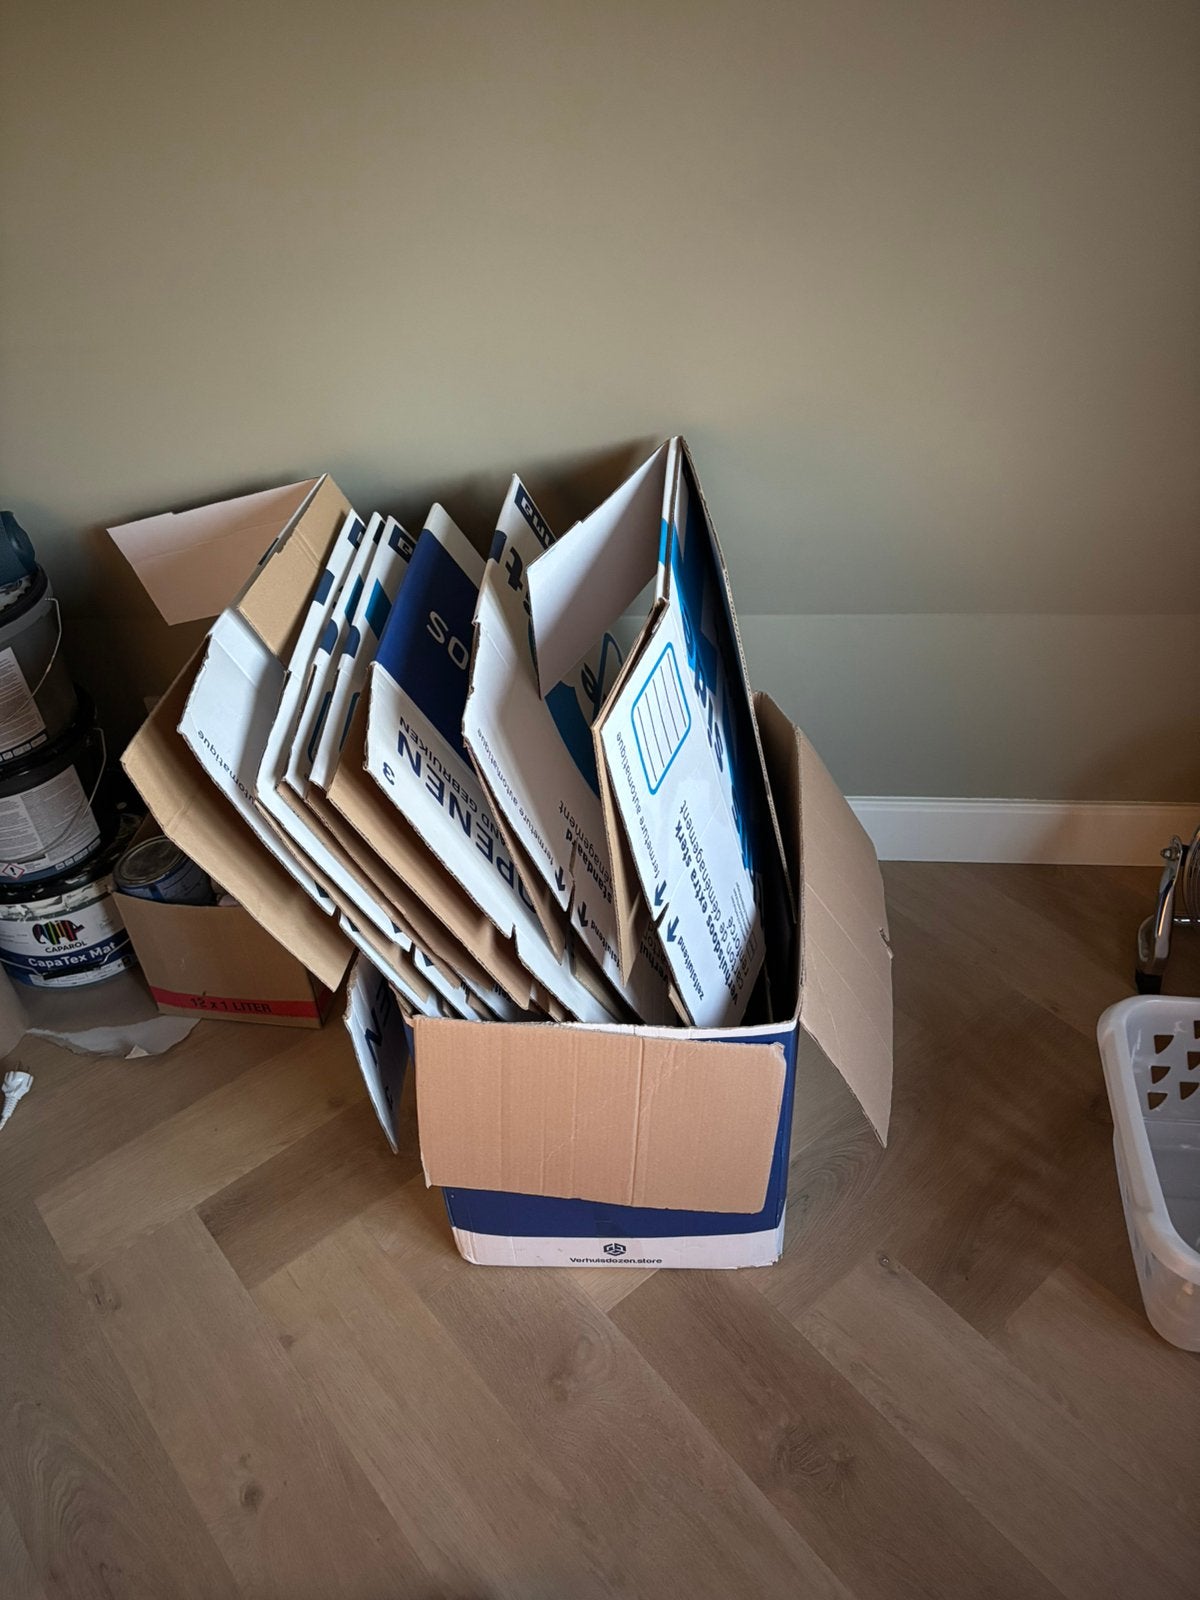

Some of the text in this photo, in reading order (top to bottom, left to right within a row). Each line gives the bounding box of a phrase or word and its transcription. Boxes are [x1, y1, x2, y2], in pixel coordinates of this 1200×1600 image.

[382, 761, 396, 786] 3
[399, 717, 477, 805] GEBRUIKEN
[477, 728, 554, 865] fermeture automatique
[616, 731, 660, 879] fermeture automatique
[679, 800, 721, 922] déménagement
[675, 819, 738, 1005] verhuisdoos extra sterk
[719, 922, 728, 942] de
[28, 942, 116, 968] CapaTex Mat
[45, 941, 88, 954] CAPAROL
[677, 935, 704, 1001] zelfsluitend
[726, 942, 744, 990] carton
[727, 916, 749, 976] renforcé
[190, 998, 207, 1008] 12
[220, 1002, 229, 1011] 1
[232, 1003, 272, 1013] LITER
